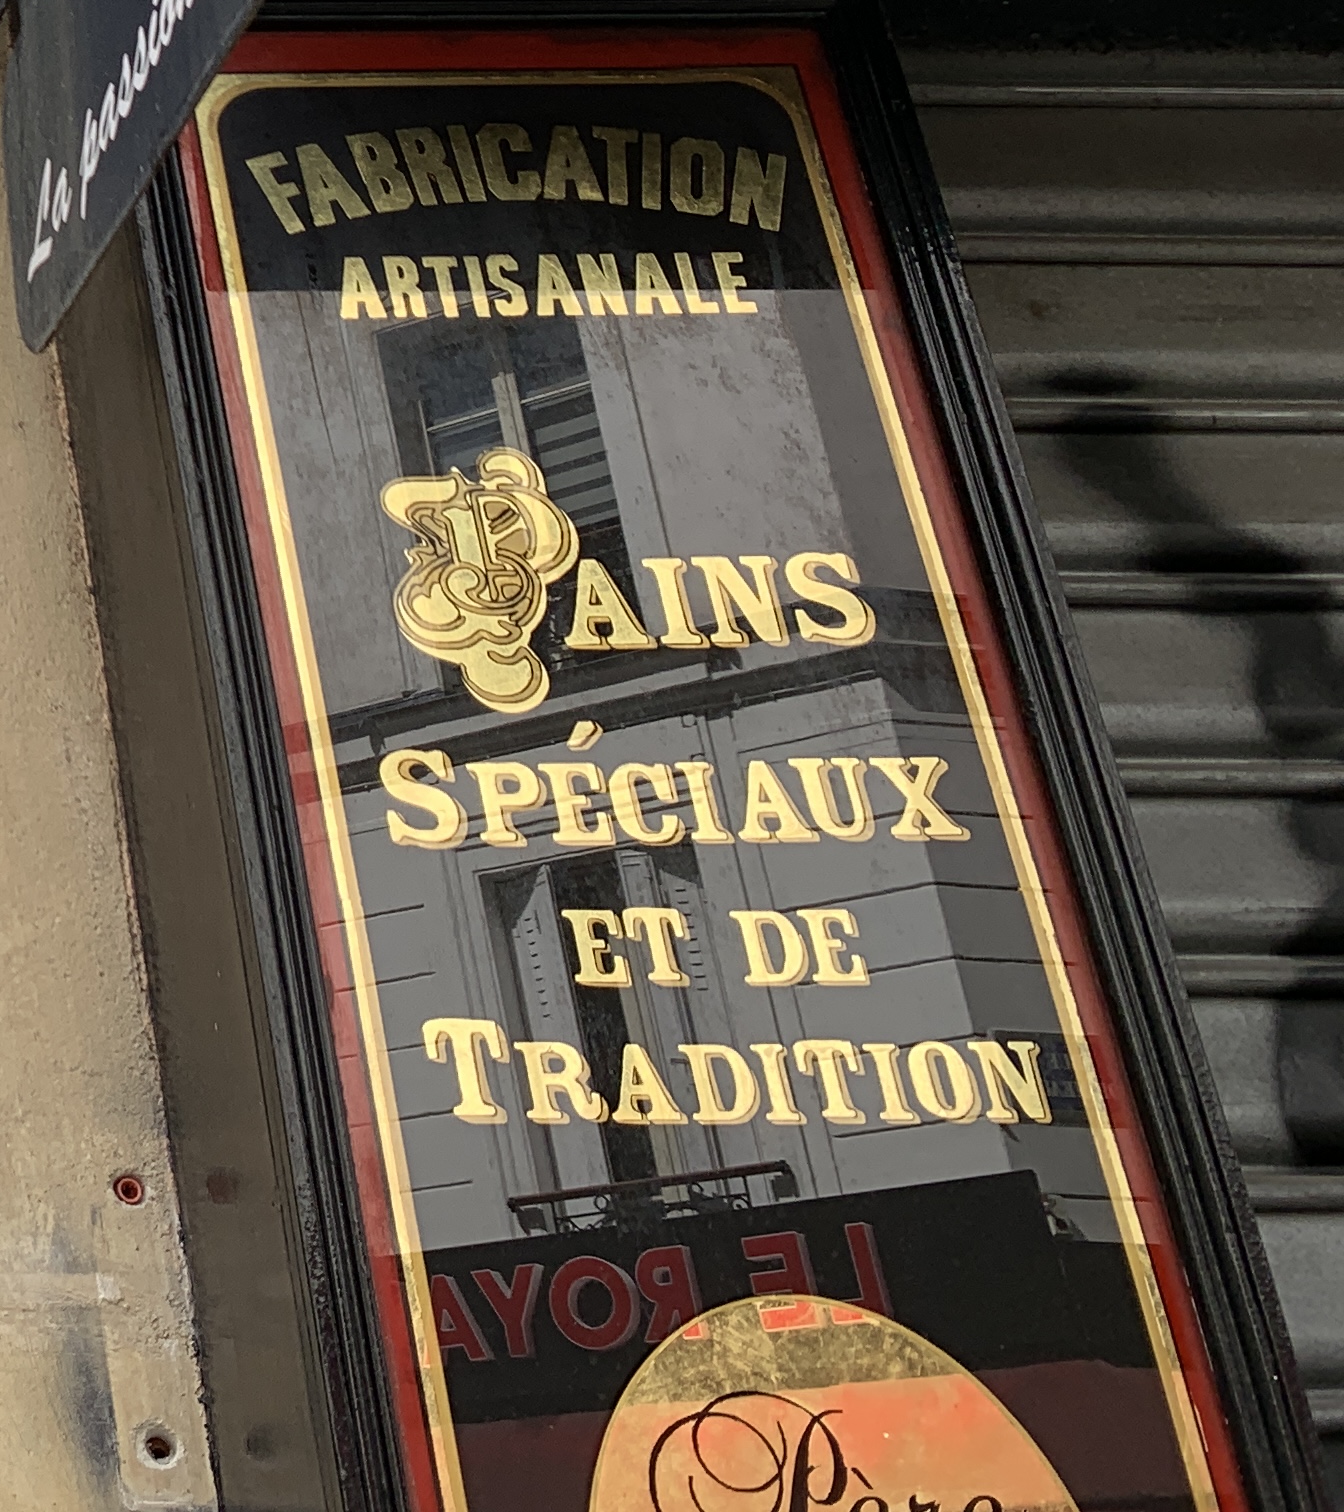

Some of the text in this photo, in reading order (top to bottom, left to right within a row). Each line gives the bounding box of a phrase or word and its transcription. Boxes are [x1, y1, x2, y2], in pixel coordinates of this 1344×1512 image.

[26, 157, 73, 283] La
[245, 122, 787, 235] FABRICATION
[339, 250, 758, 320] ARTISANALE
[380, 447, 876, 713] PAINS
[377, 719, 972, 849] SPÉCIAUX
[562, 907, 870, 988] ET DE
[421, 1016, 1054, 1126] TRADITION
